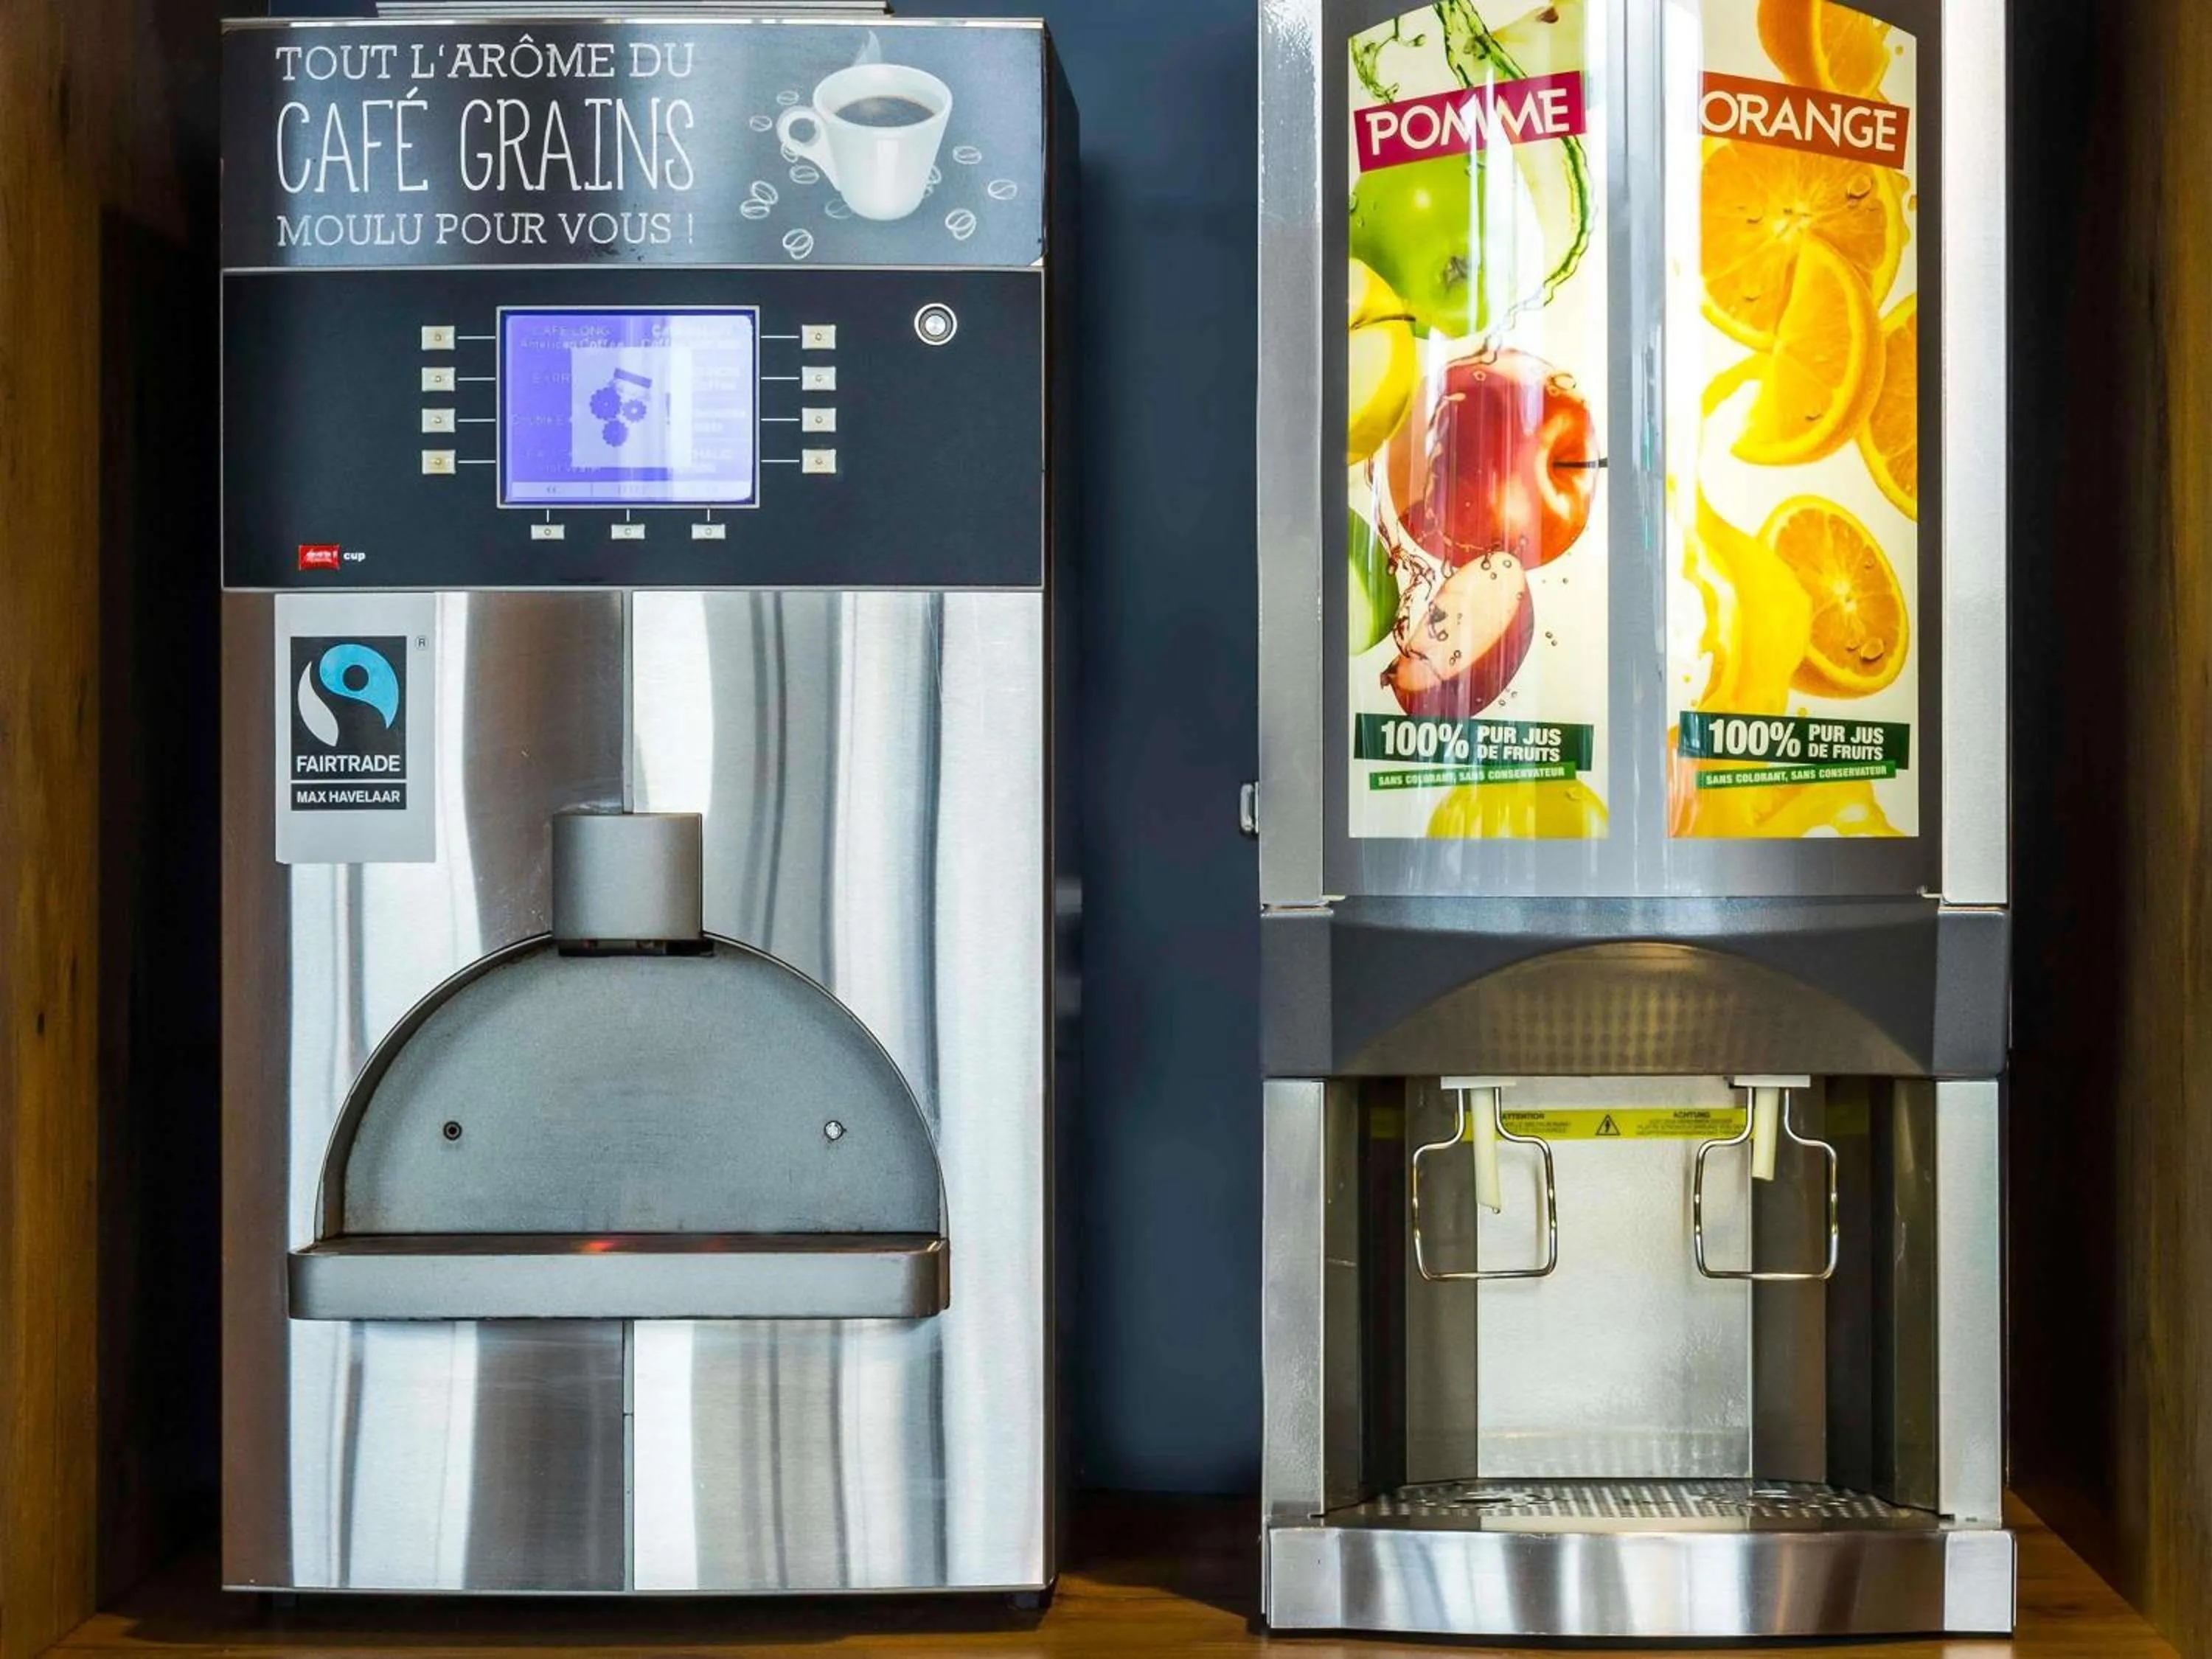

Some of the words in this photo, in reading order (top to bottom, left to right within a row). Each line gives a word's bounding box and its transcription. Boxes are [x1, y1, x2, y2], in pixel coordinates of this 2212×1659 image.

[276, 44, 398, 80] TOUT
[411, 33, 615, 79] L'ARÔME
[629, 43, 694, 77] DU
[1366, 88, 1570, 155] POMME
[1699, 91, 1897, 152] ORANGE
[276, 87, 428, 193] CAFÉ
[460, 98, 694, 192] GRAINS
[276, 215, 422, 247] MOULU
[436, 213, 547, 244] POUR
[558, 213, 672, 244] VOUS
[343, 552, 366, 563] cup
[1381, 720, 1470, 759] 100%
[1476, 726, 1517, 745] PUR
[1523, 728, 1562, 746] JUS
[1708, 719, 1801, 758] 100%
[1809, 723, 1845, 742] PUR
[1850, 726, 1885, 745] JUS
[1809, 743, 1828, 758] DE
[1832, 745, 1884, 761] FRUITS
[296, 755, 400, 773] FAIRTRADE
[1476, 745, 1498, 760] DE
[1503, 745, 1561, 762] FRUITS
[1378, 776, 1402, 786] SANS
[1459, 771, 1485, 782] SANS
[1488, 767, 1565, 780] CONSERVATEUR
[1705, 775, 1733, 785] SANS
[1736, 771, 1789, 784] COLORANT,
[1791, 769, 1816, 780] SANS
[1819, 765, 1888, 779] CONSERVATEUR
[296, 790, 327, 804] MAX
[329, 790, 400, 803] HAVELAAR
